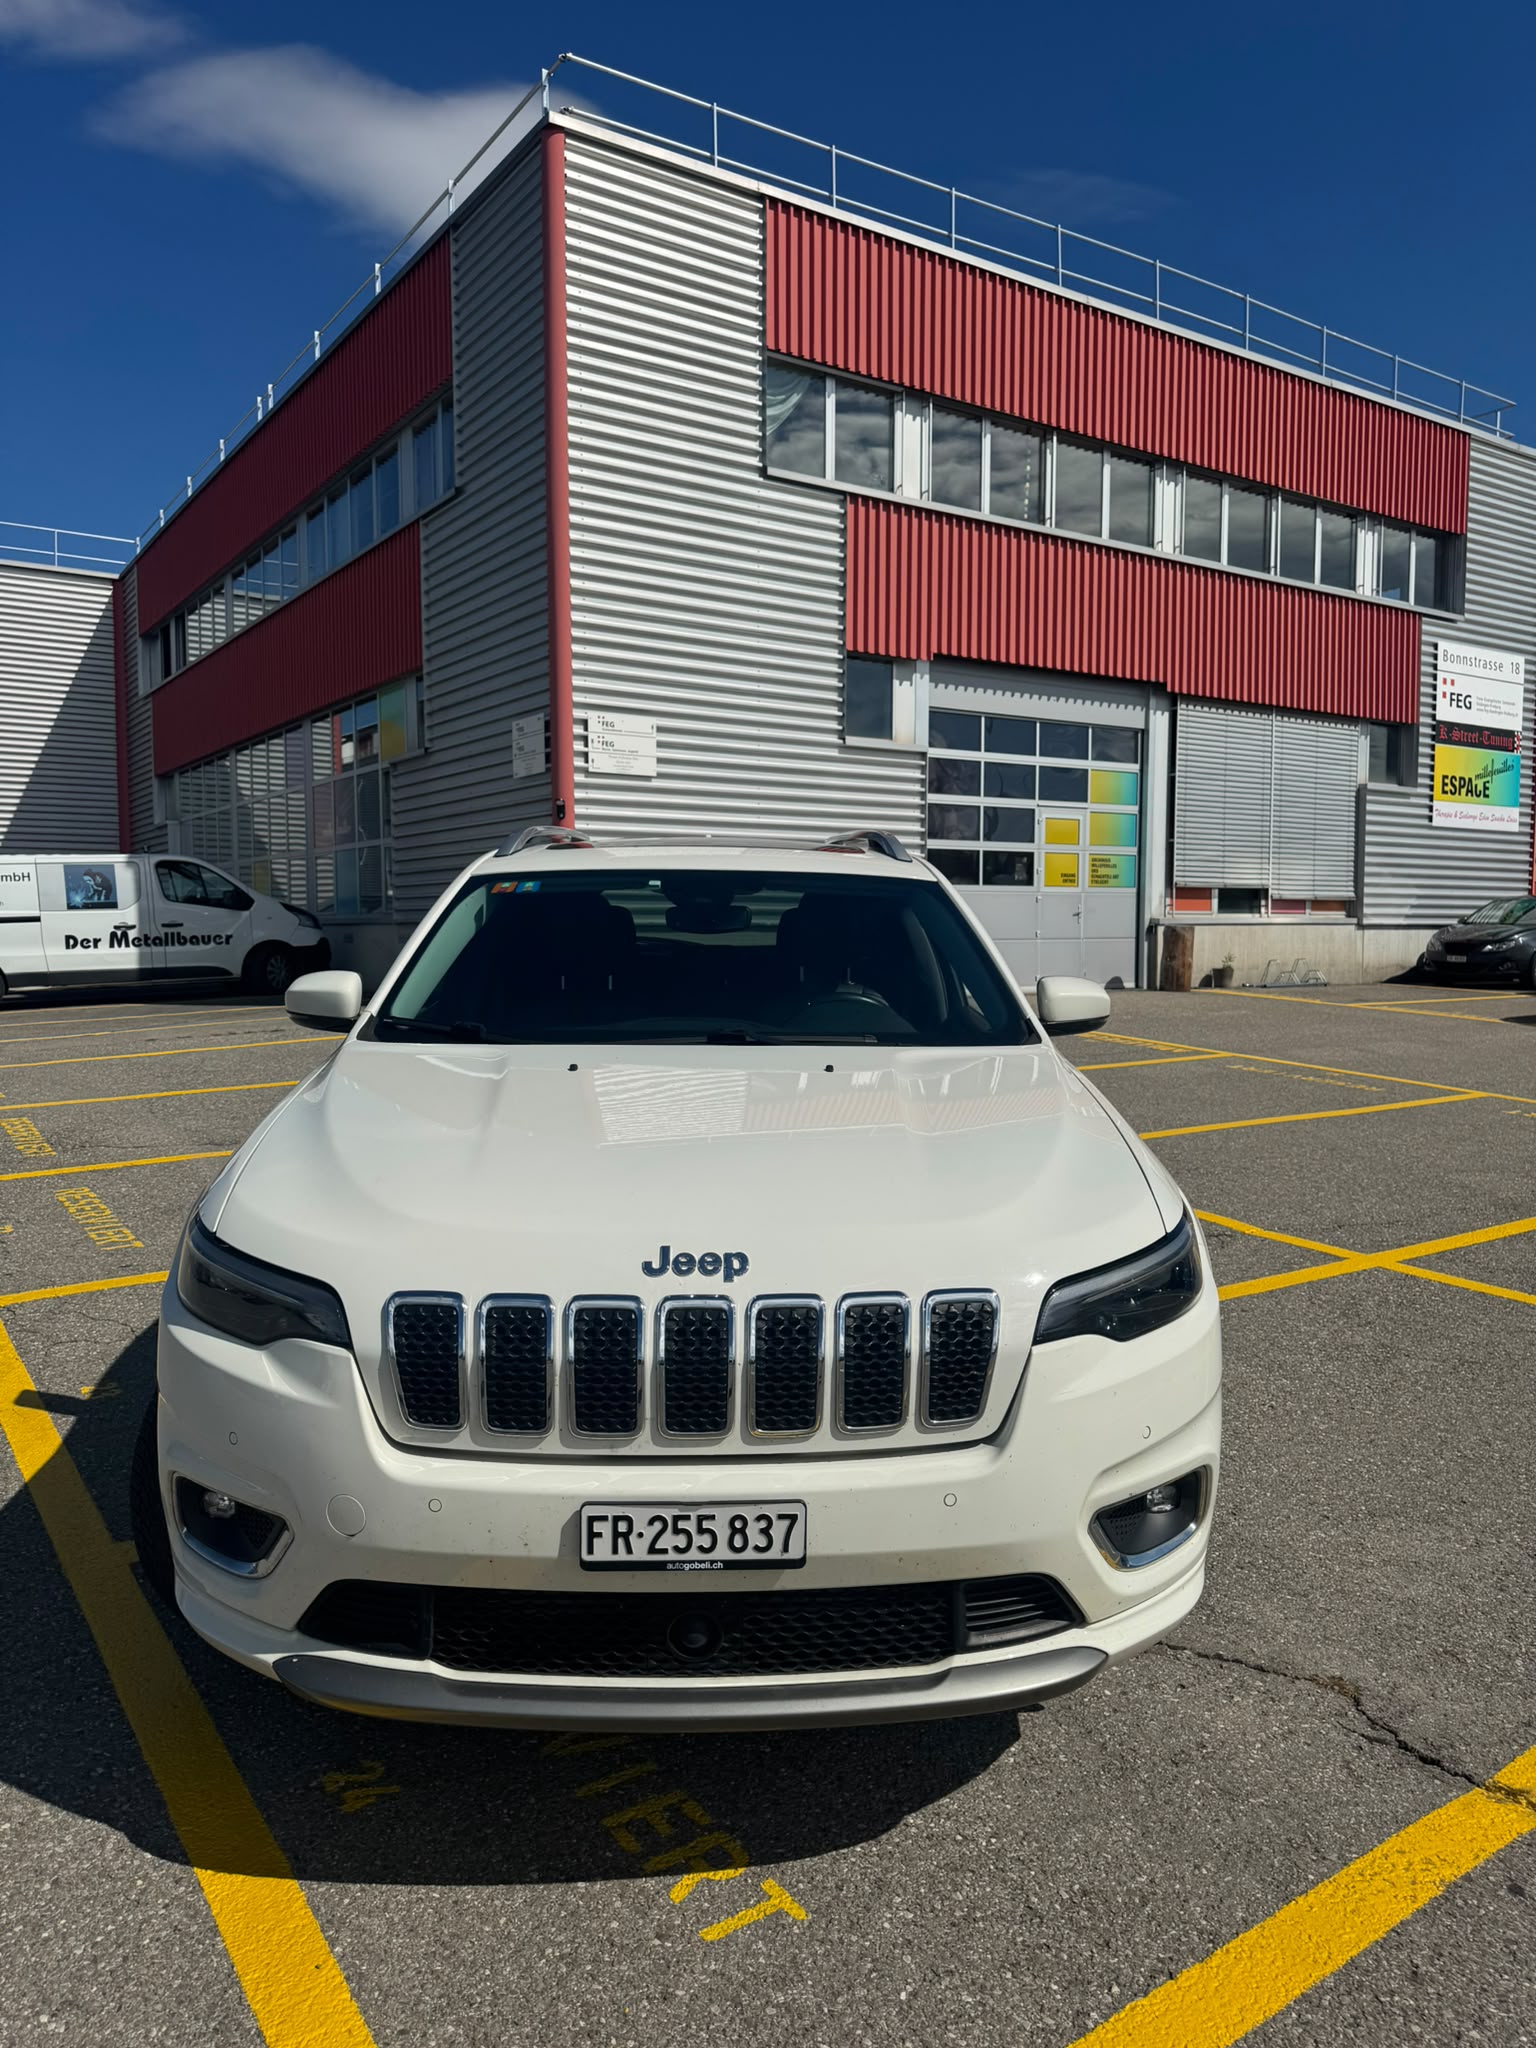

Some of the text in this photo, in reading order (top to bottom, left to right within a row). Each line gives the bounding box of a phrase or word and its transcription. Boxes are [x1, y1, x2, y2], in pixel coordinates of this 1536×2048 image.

[1443, 649, 1521, 675] Bonnstrasse 18
[1449, 692, 1472, 710] FEG
[602, 740, 615, 748] FEG
[1441, 774, 1490, 798] ESPACE
[65, 931, 233, 950] Der Metallbauer
[55, 1187, 144, 1250] RESERVIERT
[641, 1245, 749, 1283] Jeep
[728, 1513, 799, 1554] 837
[666, 1561, 723, 1571] autogobeli.ch
